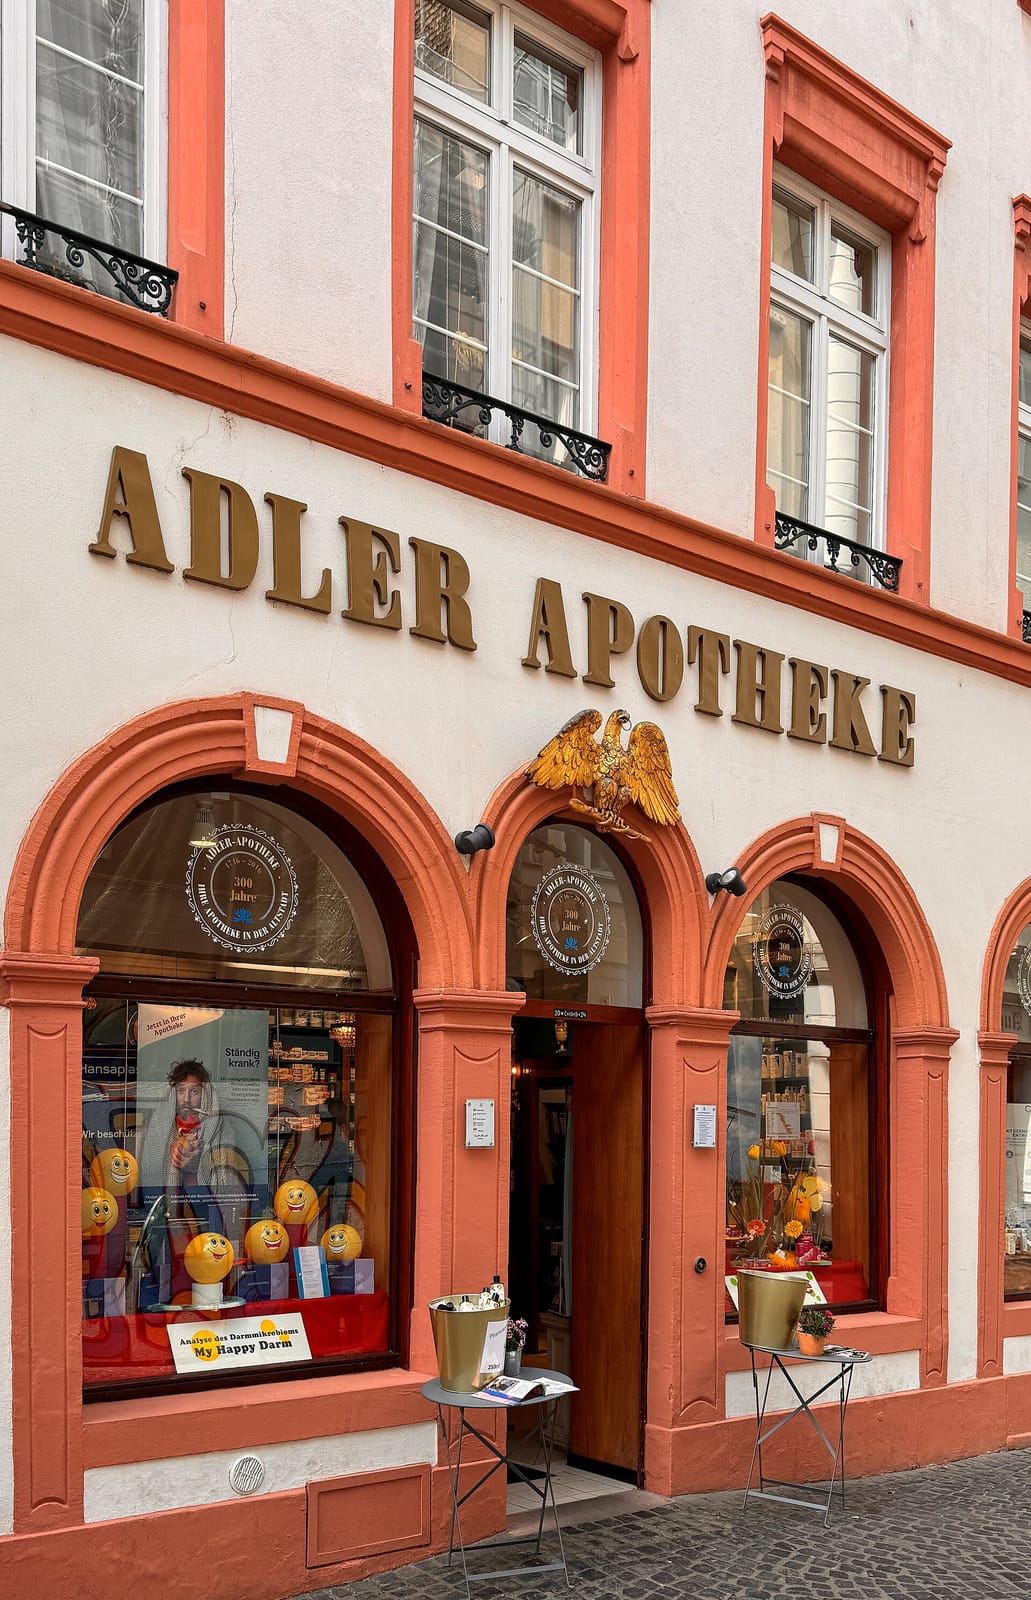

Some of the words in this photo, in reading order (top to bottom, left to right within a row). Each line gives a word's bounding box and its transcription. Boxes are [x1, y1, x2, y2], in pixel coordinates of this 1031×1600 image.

[88, 445, 477, 652] ADLER
[521, 577, 916, 767] APOTHEKE
[205, 836, 281, 871] ADLER-APOTHEKE
[234, 876, 253, 889] 300
[544, 875, 597, 905] ADLER-APOTHEKE
[229, 890, 257, 903] Jahre
[198, 883, 209, 907] IHRE
[204, 907, 240, 939] APOTHEKE
[243, 931, 252, 940] IN
[253, 926, 270, 939] DER
[269, 891, 289, 931] ALTSTADT
[564, 909, 579, 921] 300
[561, 920, 581, 933] Jahre
[544, 936, 570, 965] APOTHEKE
[570, 956, 577, 965] IN
[578, 951, 590, 964] DER
[146, 1021, 162, 1031] Jetzt
[163, 1016, 170, 1025] in
[170, 1013, 186, 1024] Ihrer
[154, 1022, 184, 1036] Apotheke
[225, 1047, 260, 1059] Ständig
[82, 1063, 138, 1077] Hansapa
[228, 1058, 260, 1068] krank?
[180, 1336, 213, 1346] Analyse
[214, 1334, 228, 1342] des
[229, 1328, 299, 1341] Darmmikrobioms
[194, 1346, 213, 1358] My
[216, 1342, 256, 1355] Happy
[259, 1340, 293, 1351] Darm
